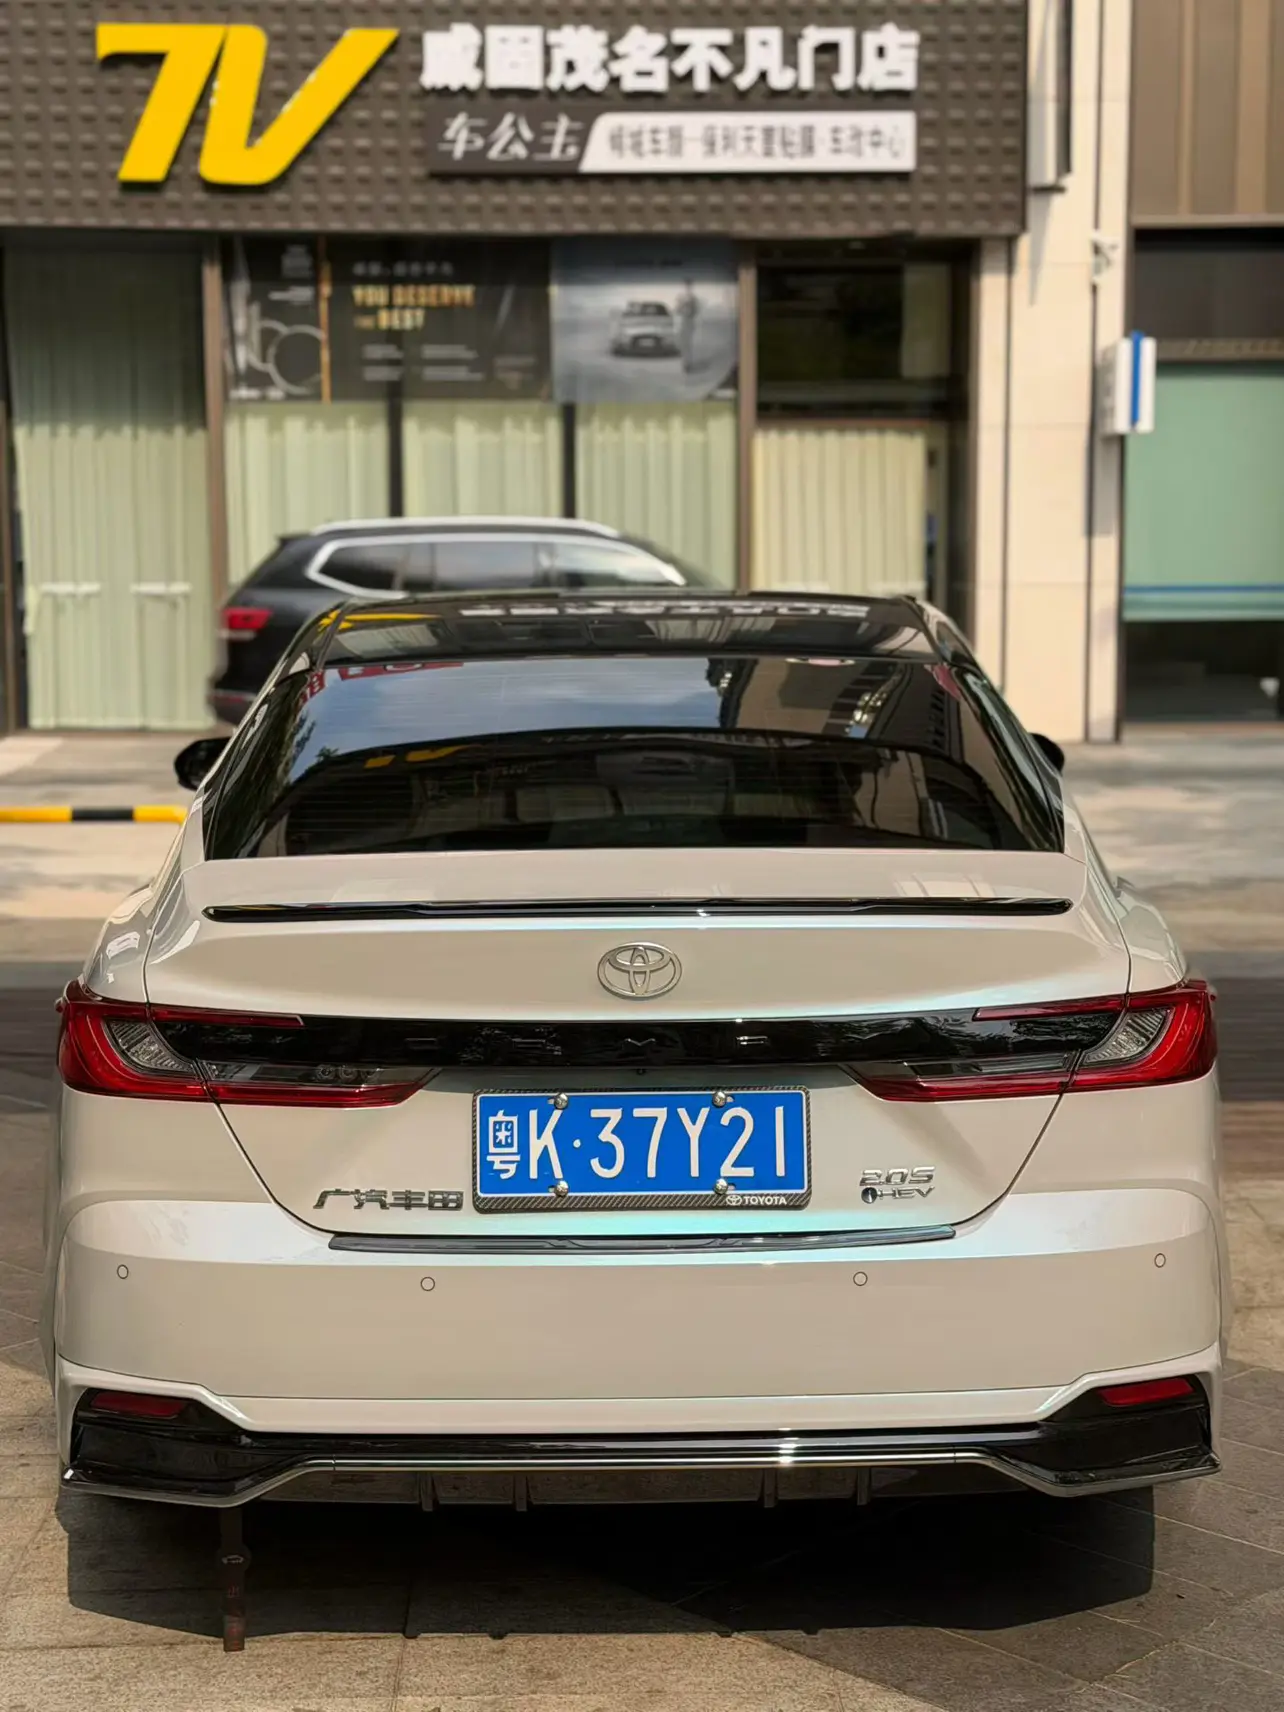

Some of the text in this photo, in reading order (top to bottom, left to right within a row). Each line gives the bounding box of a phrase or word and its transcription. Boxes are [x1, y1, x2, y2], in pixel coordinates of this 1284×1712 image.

[438, 111, 585, 161] 车公主
[859, 1166, 935, 1186] 2.0S
[313, 1188, 464, 1211] 广汽丰田
[744, 1195, 787, 1206] TOYOTA
